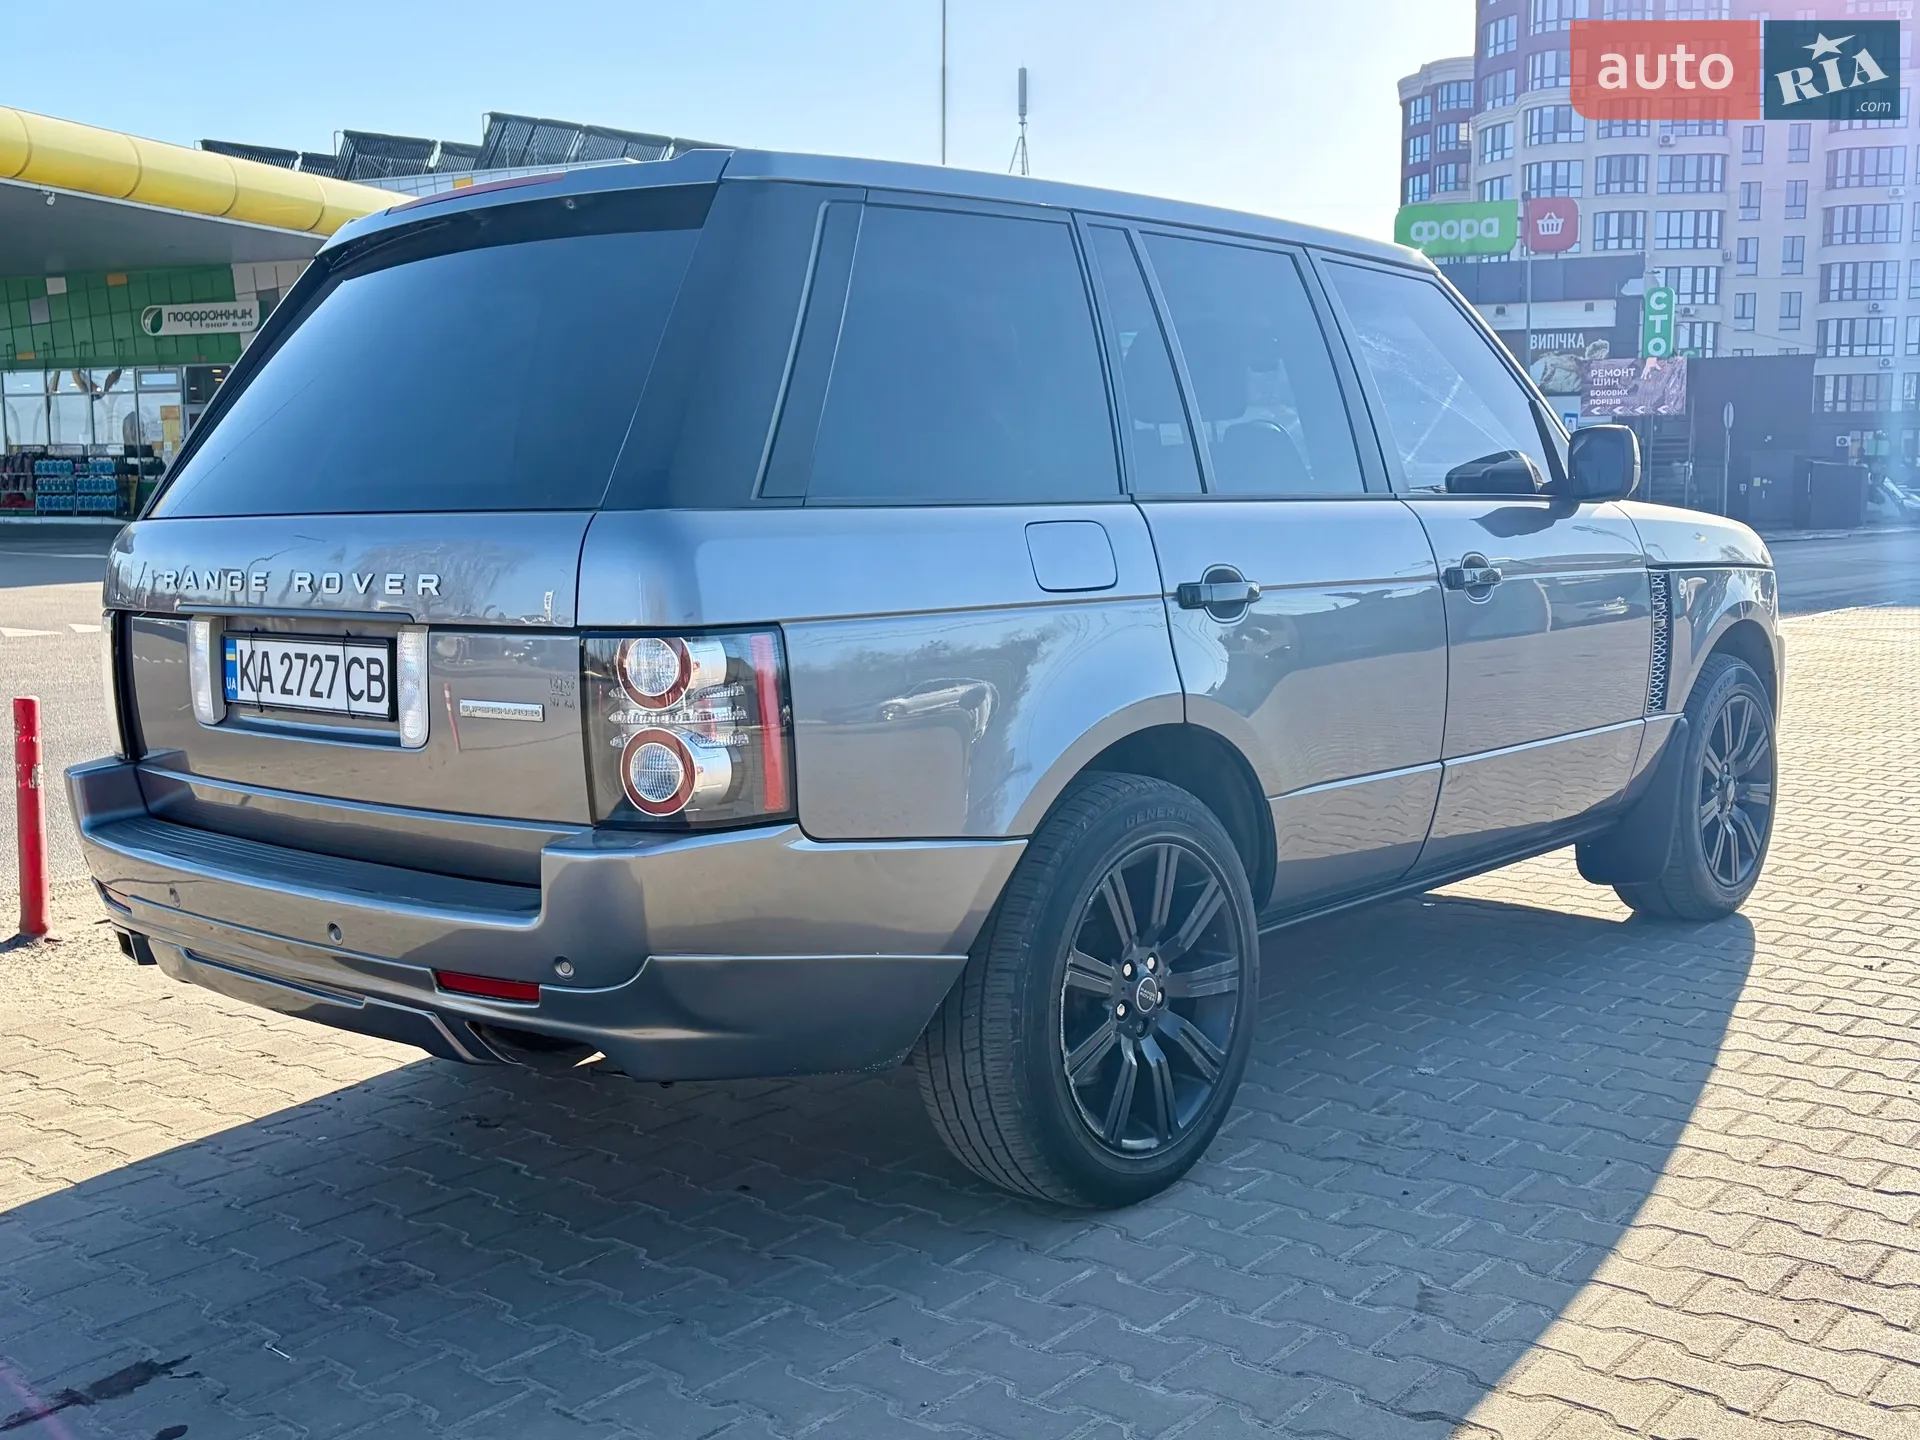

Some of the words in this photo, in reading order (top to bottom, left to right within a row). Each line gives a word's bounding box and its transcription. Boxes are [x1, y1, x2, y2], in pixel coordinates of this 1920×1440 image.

[1411, 217, 1499, 245] фора
[167, 308, 253, 328] подорожник
[1648, 291, 1668, 356] СТО
[1530, 333, 1585, 349] ВИПІЧКА
[1591, 368, 1636, 377] РЕМОНТ
[1593, 378, 1619, 386] ШИН
[163, 569, 272, 593] RANGE
[293, 571, 442, 596] ROVER
[226, 676, 237, 691] UA
[239, 649, 275, 694] KA
[280, 652, 340, 700] 2727
[346, 656, 386, 703] CB
[461, 704, 541, 717] SUPERCHARGED
